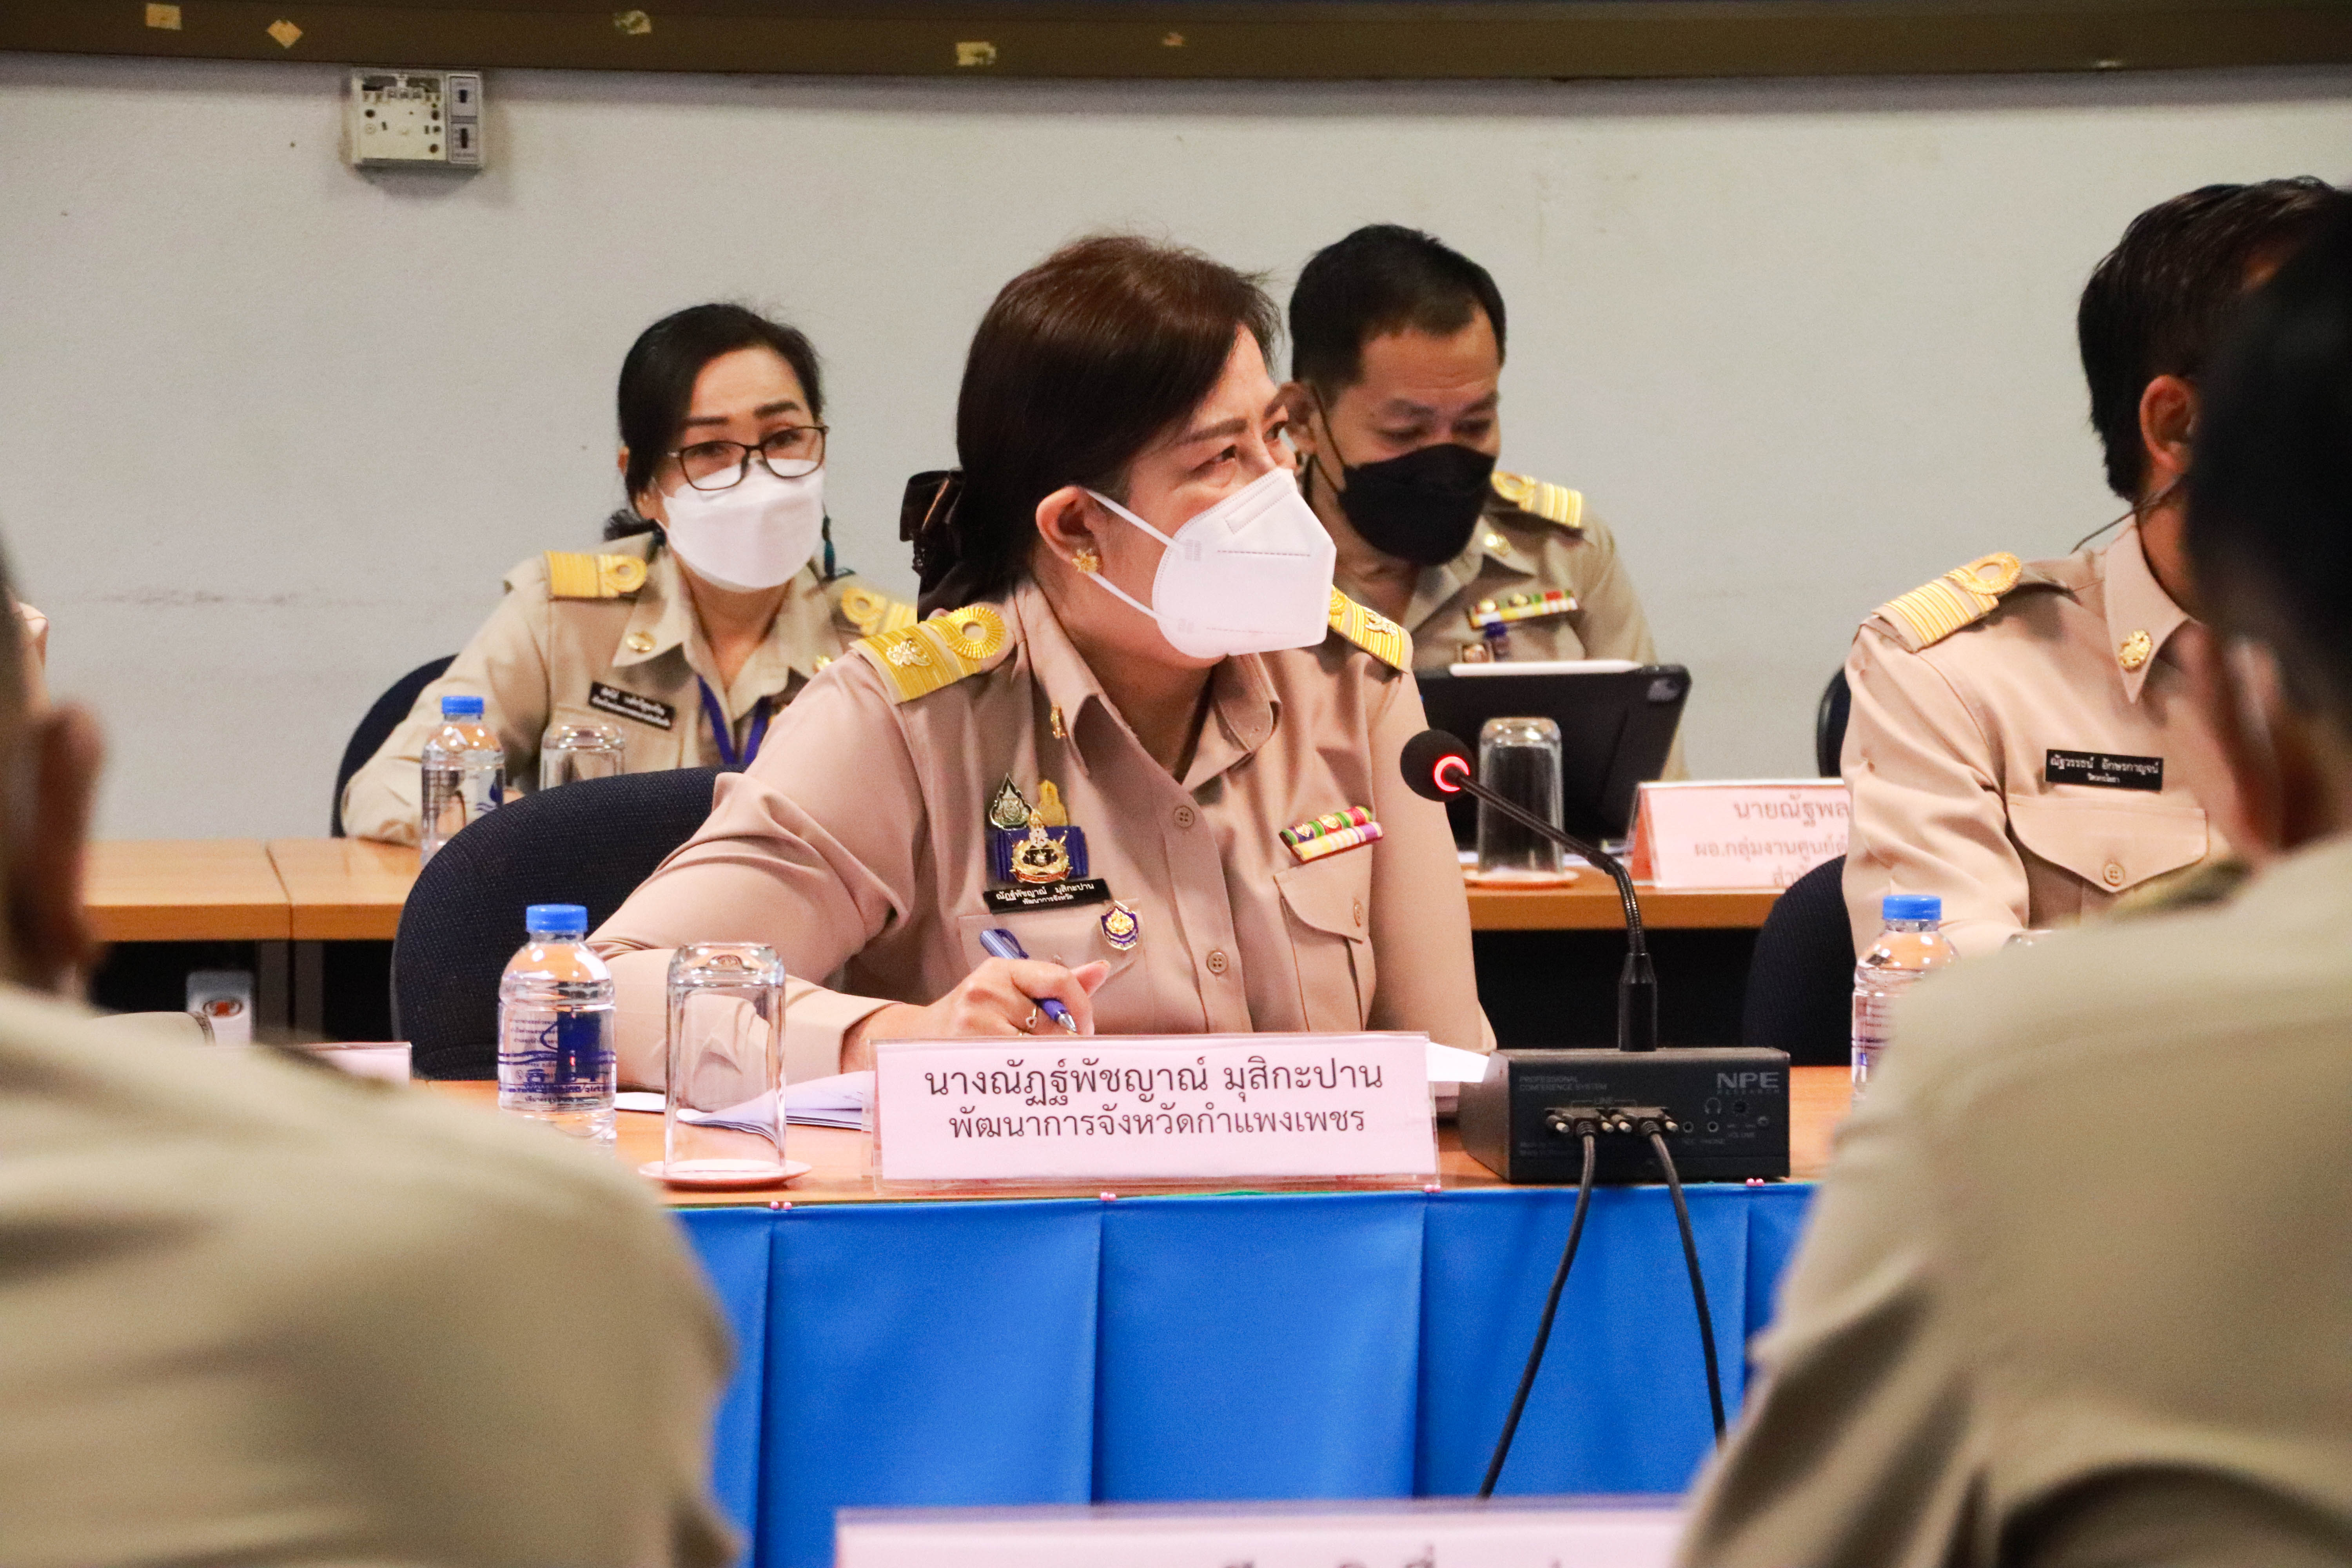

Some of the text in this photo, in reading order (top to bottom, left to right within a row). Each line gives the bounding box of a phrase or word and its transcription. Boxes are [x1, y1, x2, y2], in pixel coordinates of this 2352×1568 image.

[925, 1056, 1383, 1106] นางณัฏฐ์พัชญาณ์ มุสิกะปาน
[1717, 1072, 1779, 1088] NPE
[949, 1102, 1365, 1138] พัฒนาการจังหวัดกำแพงเพชร
